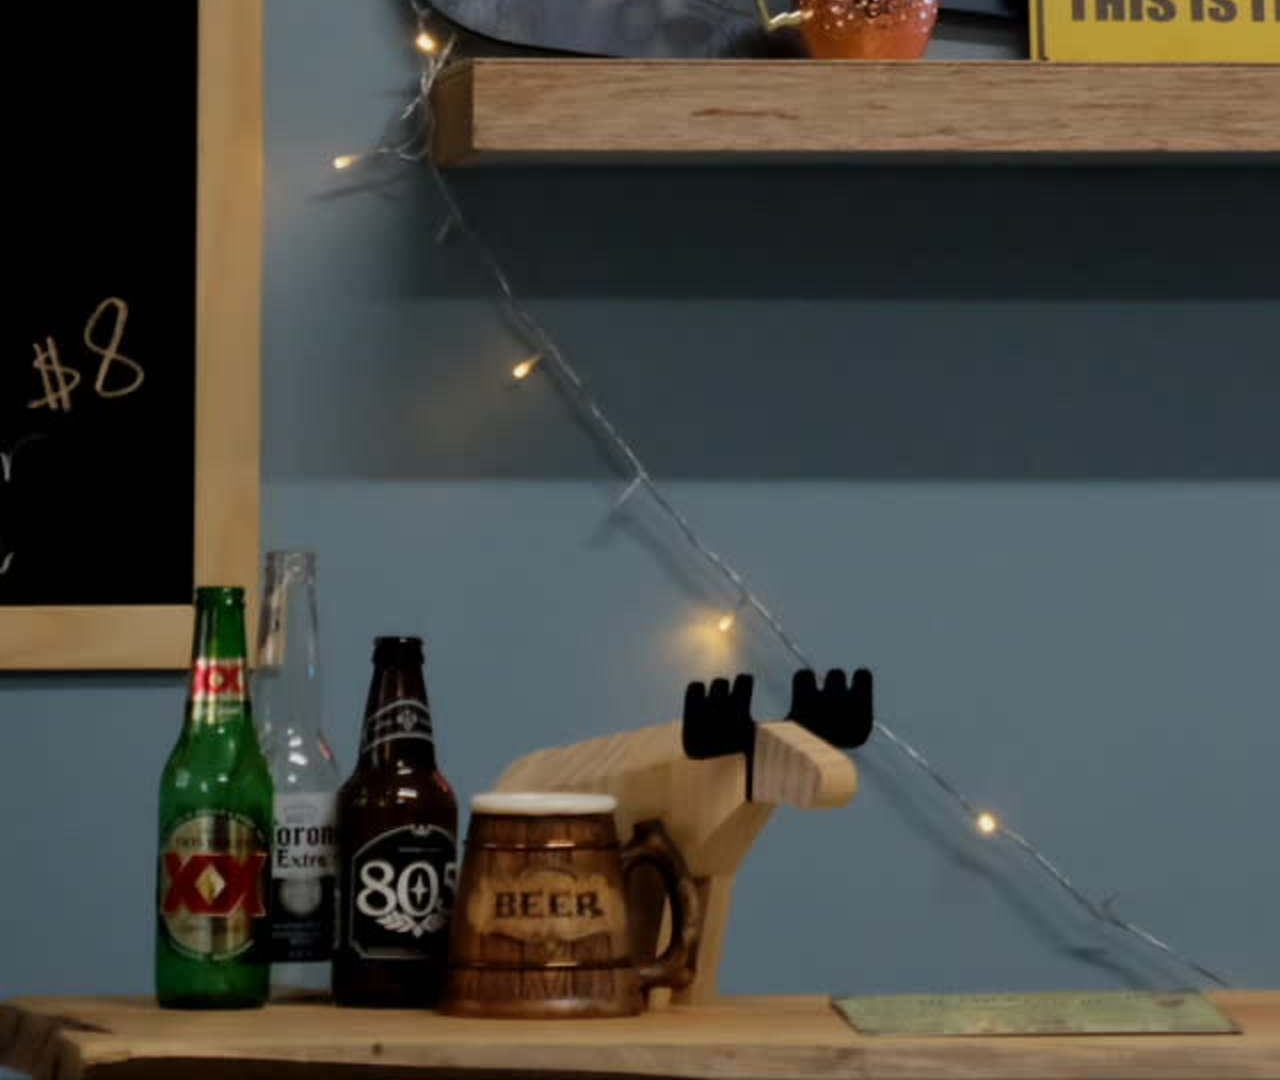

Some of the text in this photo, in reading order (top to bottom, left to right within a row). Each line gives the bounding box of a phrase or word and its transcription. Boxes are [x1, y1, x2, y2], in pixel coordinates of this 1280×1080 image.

[28, 296, 145, 412] $8
[277, 826, 337, 846] oron
[495, 891, 605, 918] BEER
